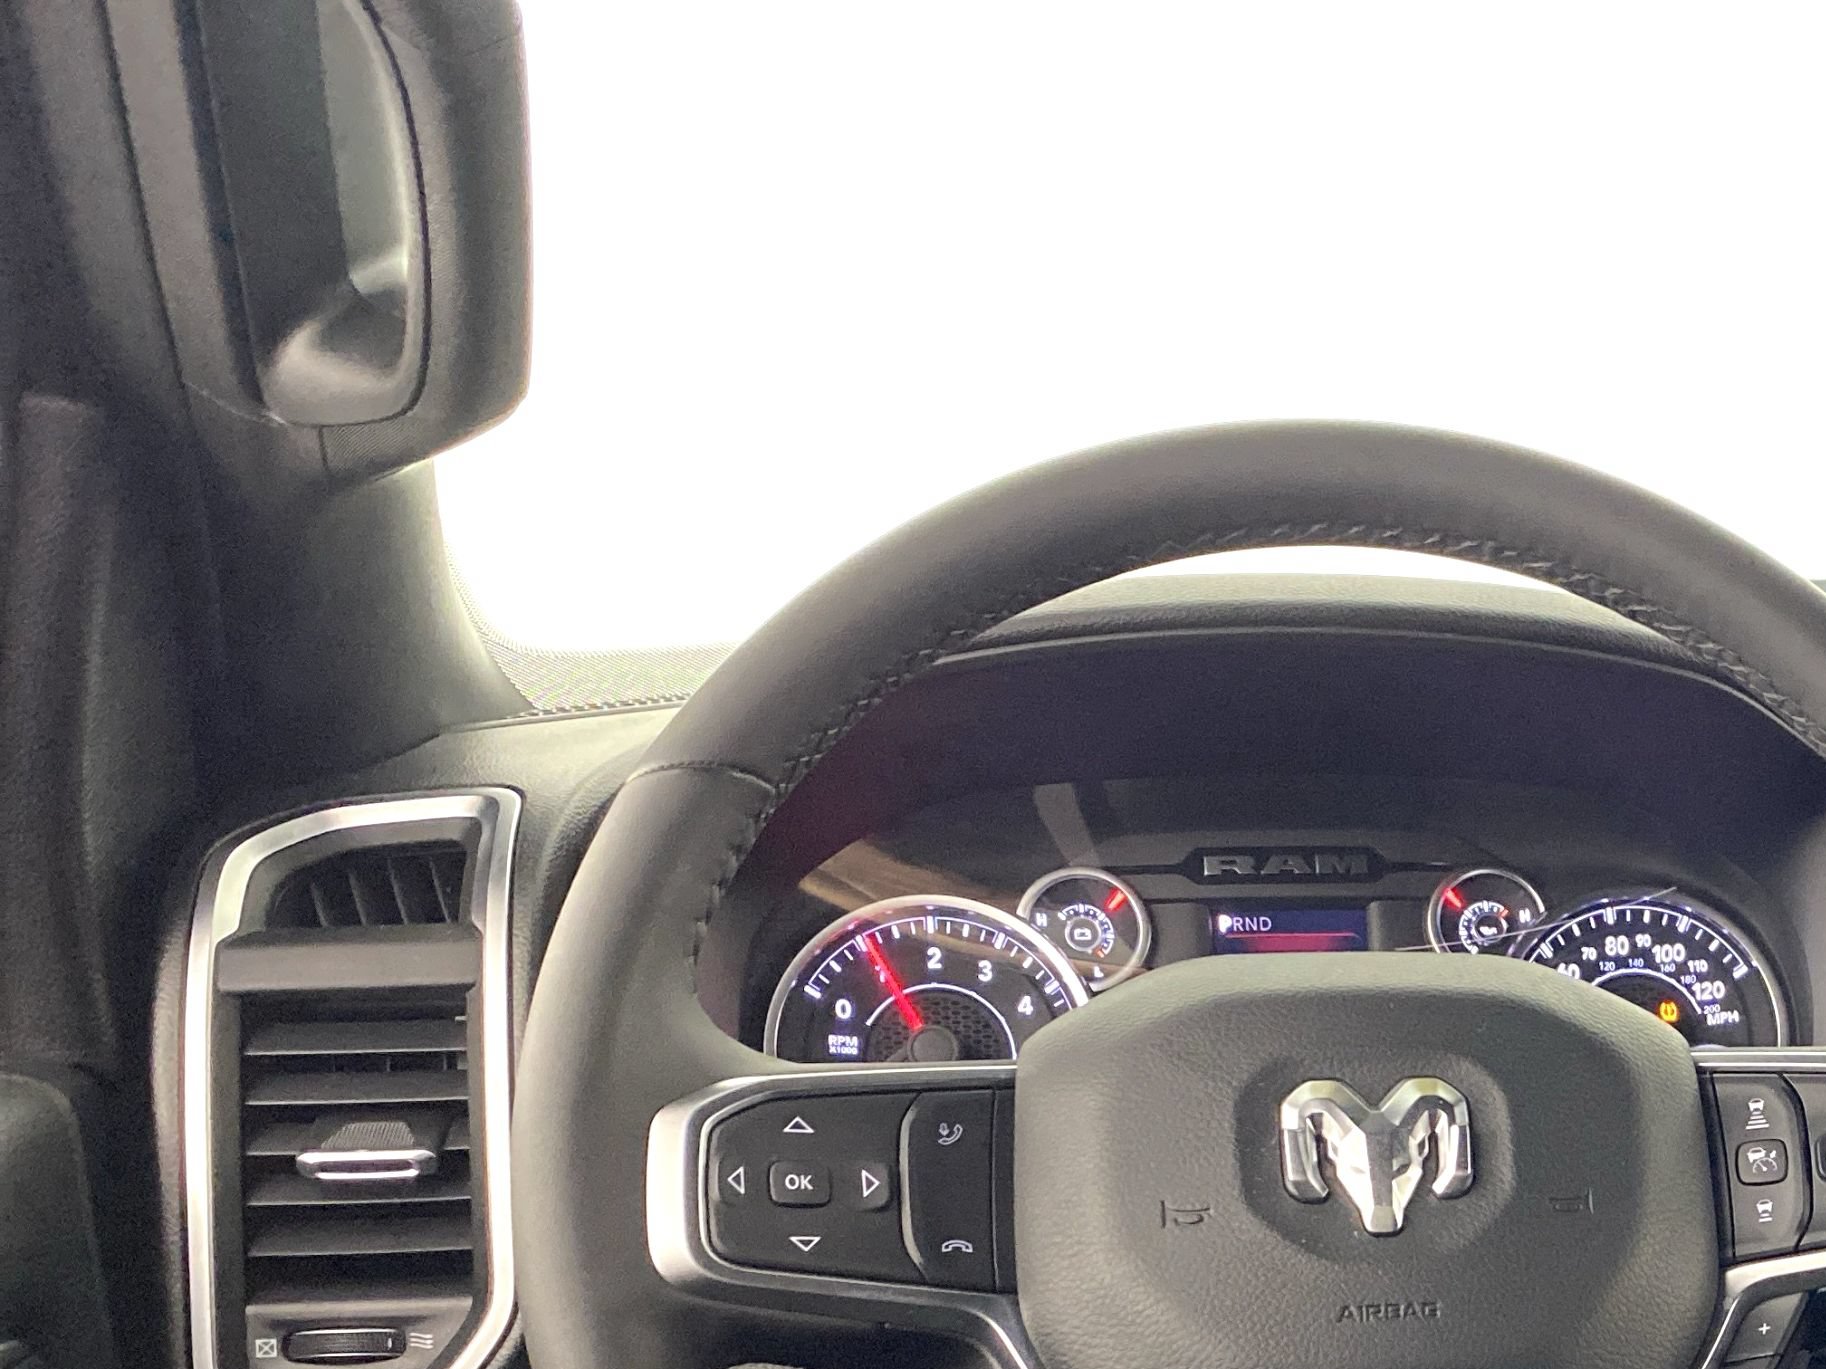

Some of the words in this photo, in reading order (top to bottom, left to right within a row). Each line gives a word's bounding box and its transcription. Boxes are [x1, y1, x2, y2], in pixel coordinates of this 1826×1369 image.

[1203, 855, 1368, 876] RAM
[1605, 935, 1629, 955] 80
[1635, 934, 1651, 947] 90
[927, 947, 943, 969] 2
[1581, 947, 1597, 960] 70
[1652, 943, 1686, 962] 100
[978, 960, 993, 981] 3
[1599, 962, 1616, 971] 120
[1628, 959, 1644, 968] 140
[1688, 960, 1708, 973] 110
[1692, 981, 1725, 1000] 120
[835, 999, 852, 1019] 0
[1018, 995, 1033, 1015] 4
[1707, 1011, 1739, 1025] MPH
[828, 1035, 858, 1047] RPM
[785, 1175, 813, 1190] OK
[1336, 1301, 1441, 1323] AIRBAG
